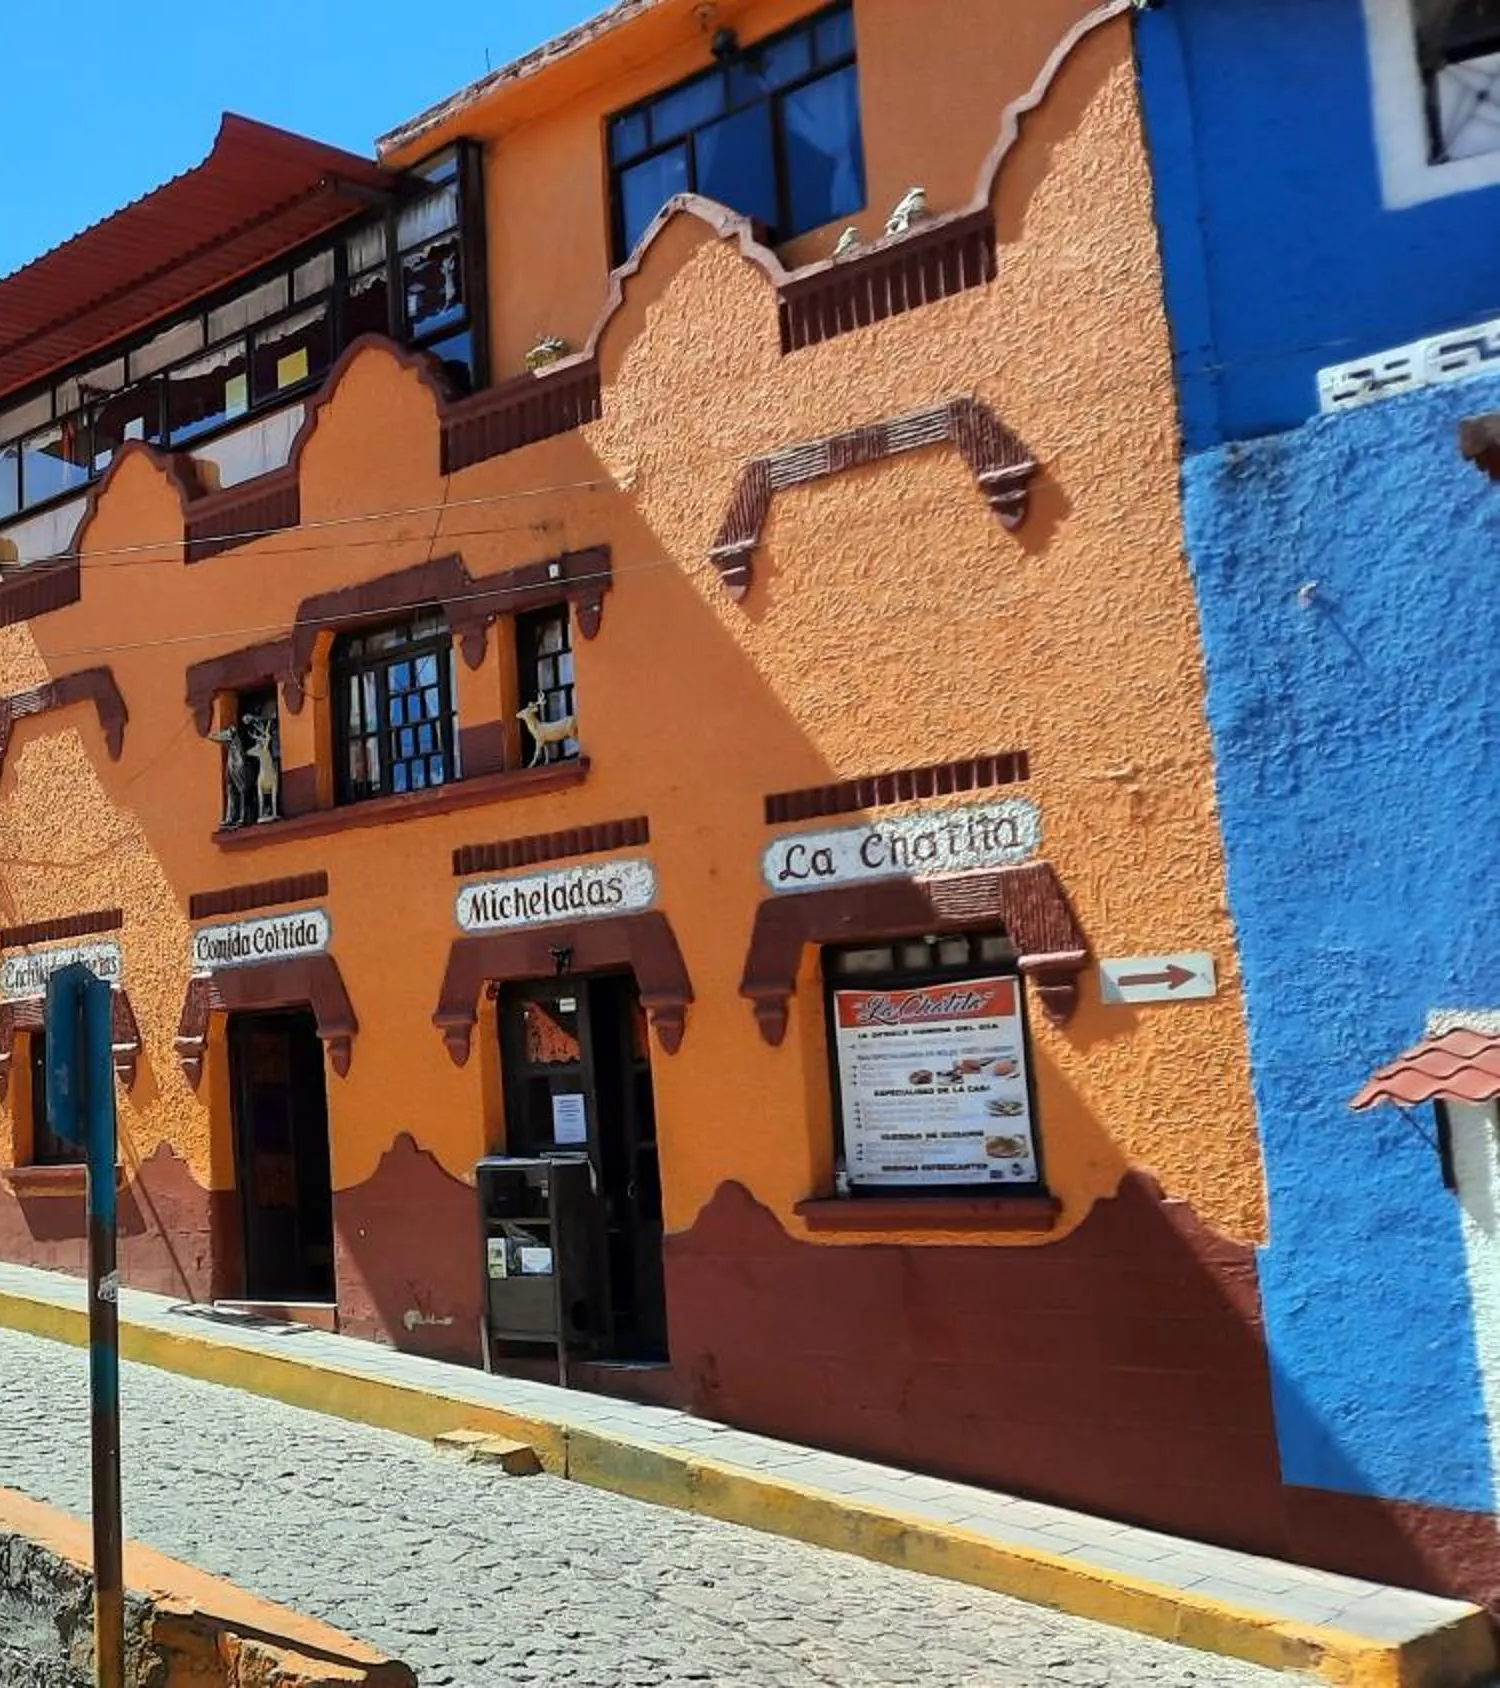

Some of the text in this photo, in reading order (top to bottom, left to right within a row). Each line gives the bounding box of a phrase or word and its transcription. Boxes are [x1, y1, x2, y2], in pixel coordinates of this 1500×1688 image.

[779, 810, 1022, 881] La Chatita
[468, 876, 623, 927] Micheladas
[197, 919, 318, 962] Comida Corrida
